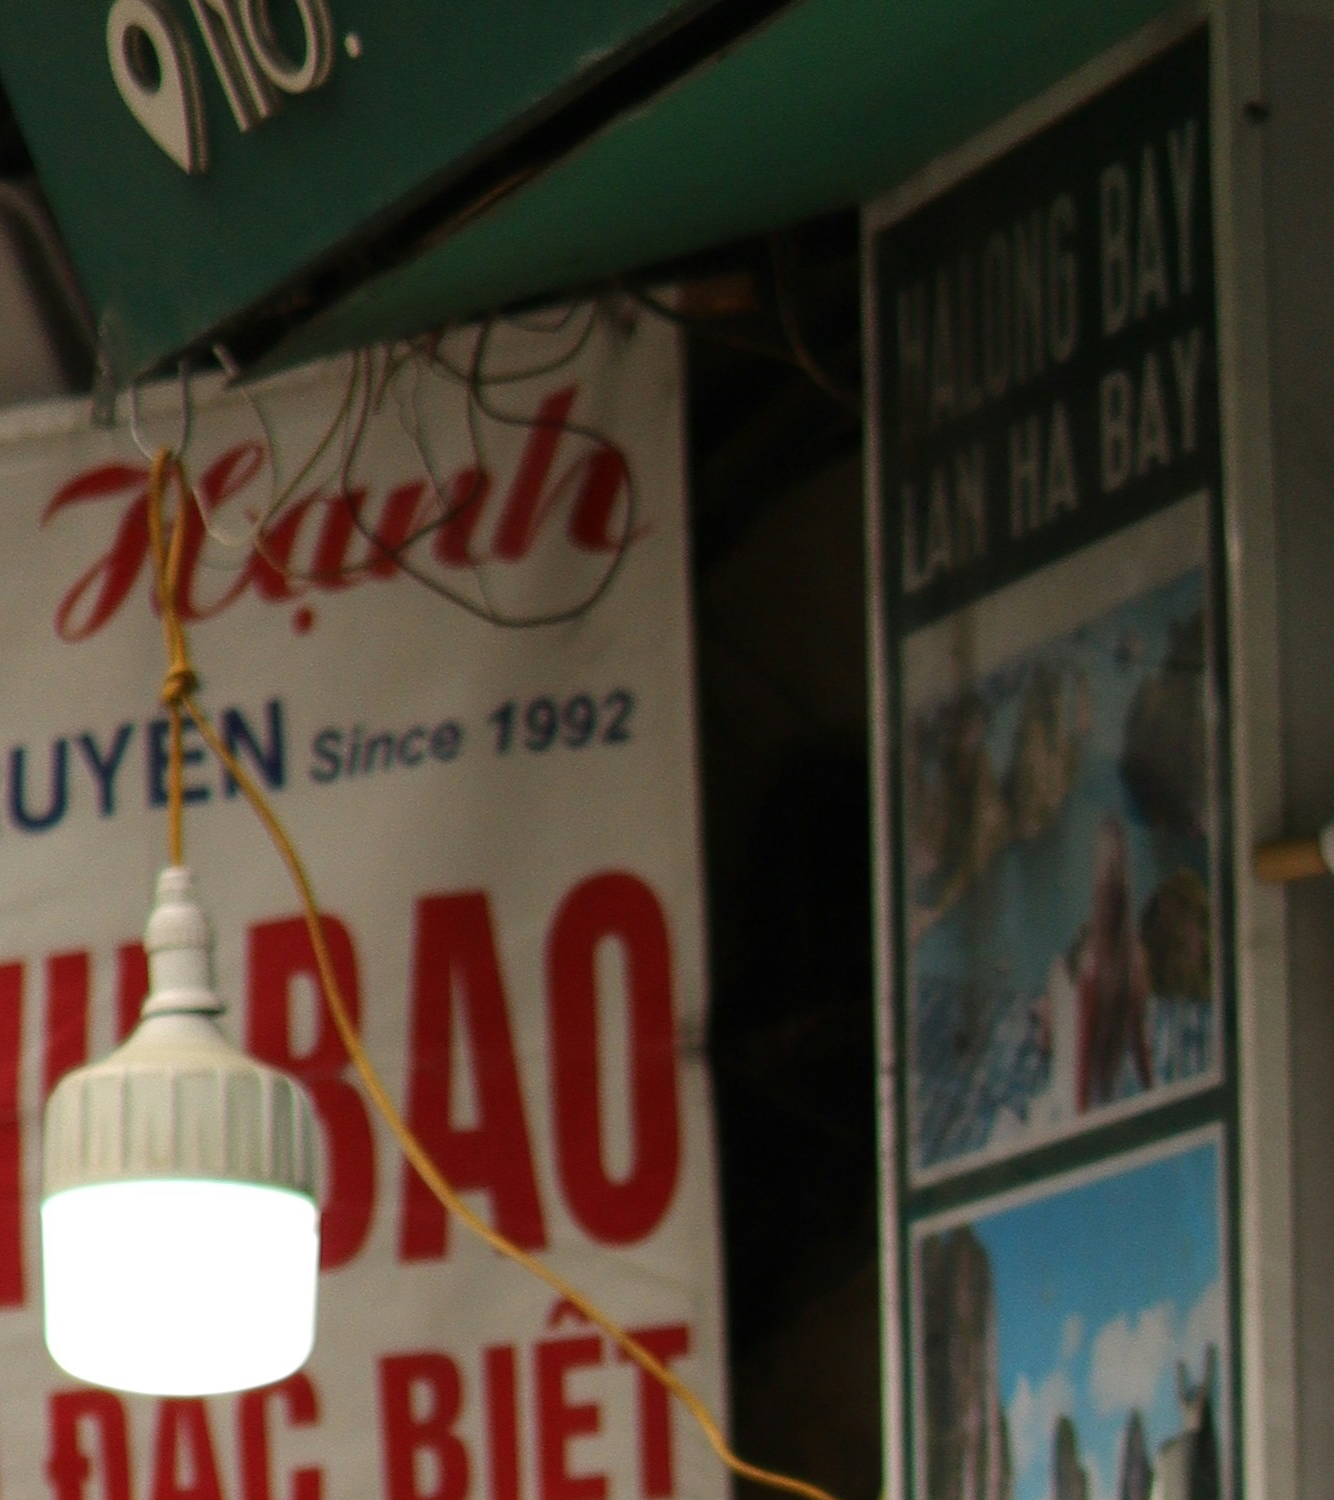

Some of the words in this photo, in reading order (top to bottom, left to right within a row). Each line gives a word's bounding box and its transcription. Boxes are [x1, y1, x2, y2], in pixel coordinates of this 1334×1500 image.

[1100, 119, 1201, 337] BAY
[40, 384, 650, 645] Hạnh
[900, 441, 987, 597] LAN
[1009, 400, 1079, 540] HA
[1100, 326, 1204, 496] BAY
[310, 717, 462, 786] Since
[485, 691, 636, 756] 1992
[246, 868, 683, 1274] BAO
